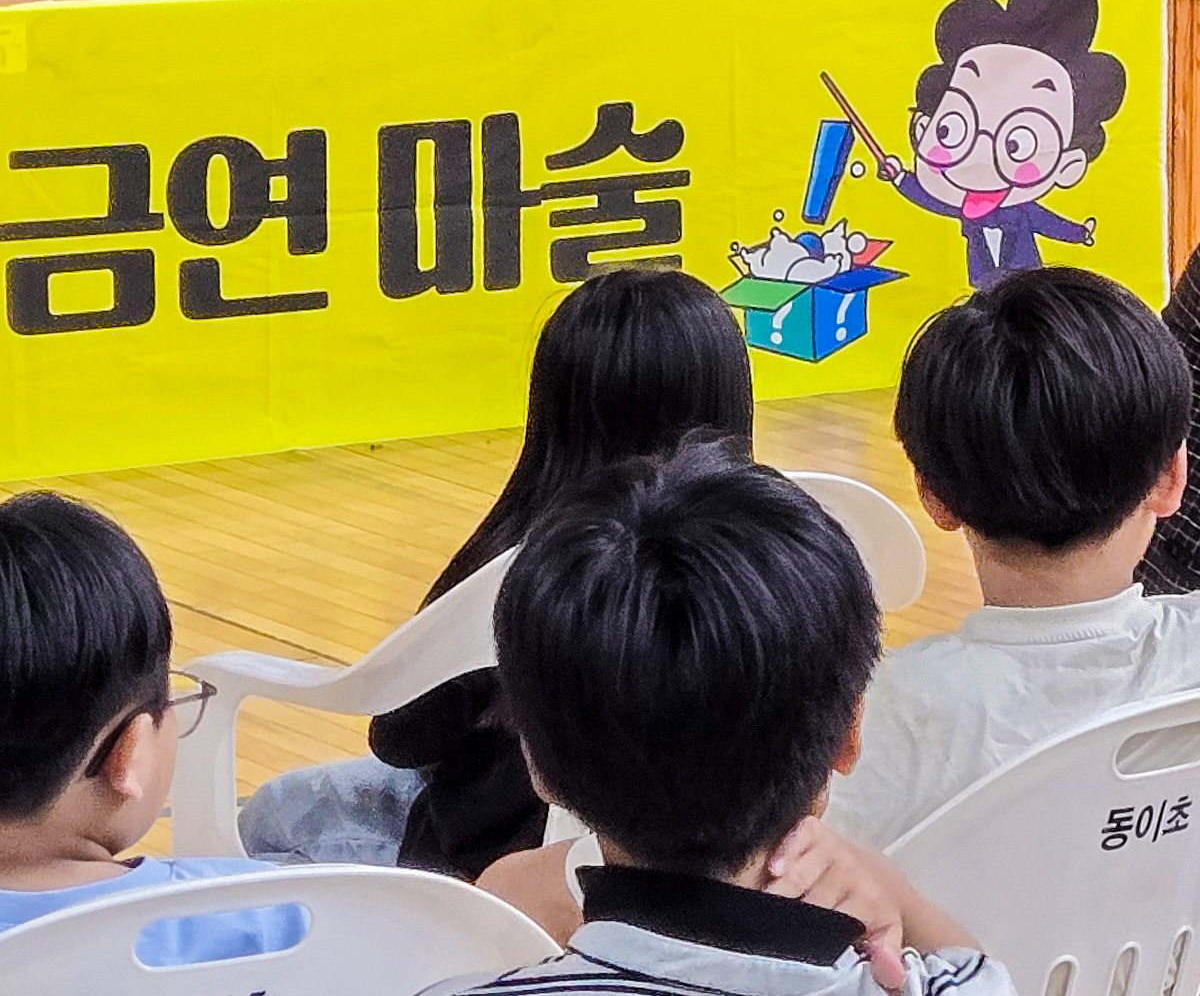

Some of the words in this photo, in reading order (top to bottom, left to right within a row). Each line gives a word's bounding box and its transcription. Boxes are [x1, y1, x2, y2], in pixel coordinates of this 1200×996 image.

[0, 128, 330, 336] 금연
[378, 101, 691, 300] 마술
[1101, 795, 1193, 851] 동이초
